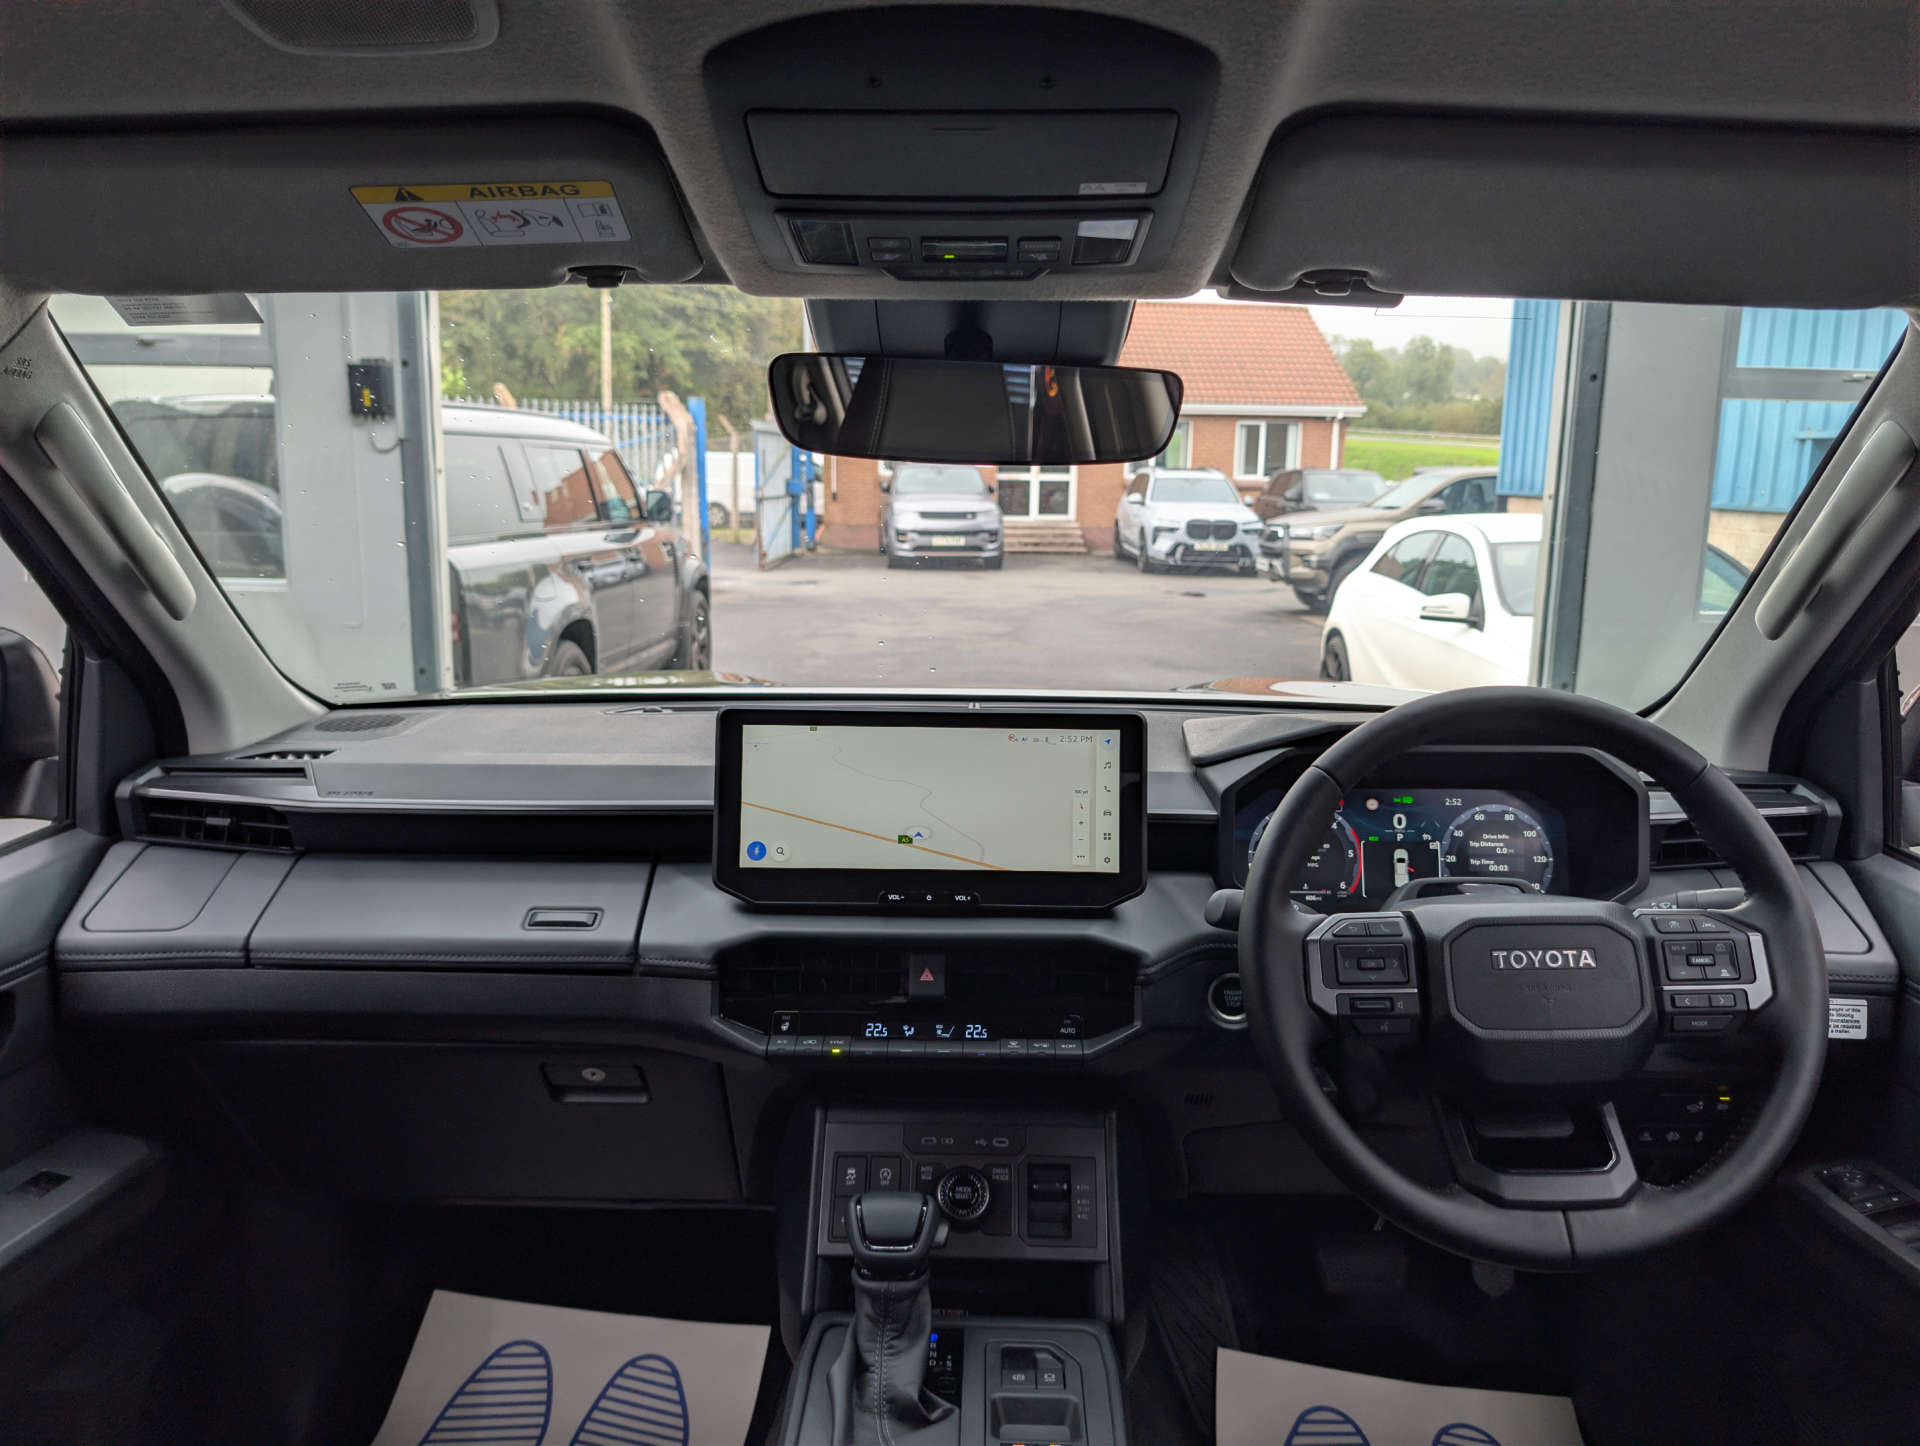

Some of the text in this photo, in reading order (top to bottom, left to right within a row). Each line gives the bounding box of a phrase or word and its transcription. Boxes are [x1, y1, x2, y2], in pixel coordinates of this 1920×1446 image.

[469, 184, 581, 199] AIRBAG
[1059, 735, 1093, 743] 2:52 PM
[1445, 798, 1463, 806] 2:52
[1393, 813, 1407, 830] 0
[1474, 813, 1485, 822] 60
[1504, 813, 1515, 822] 80
[1330, 821, 1337, 829] 4
[1397, 832, 1404, 842] P
[1453, 829, 1464, 838] 40
[1523, 829, 1537, 838] 100
[1469, 841, 1480, 849] Trip
[1347, 850, 1354, 858] 5
[1446, 855, 1457, 863] 20
[1533, 855, 1547, 863] 120
[1339, 881, 1346, 889] 6
[1492, 950, 1597, 968] TOYOTA
[865, 1022, 888, 1037] 22.5
[965, 1024, 988, 1039] 22.5
